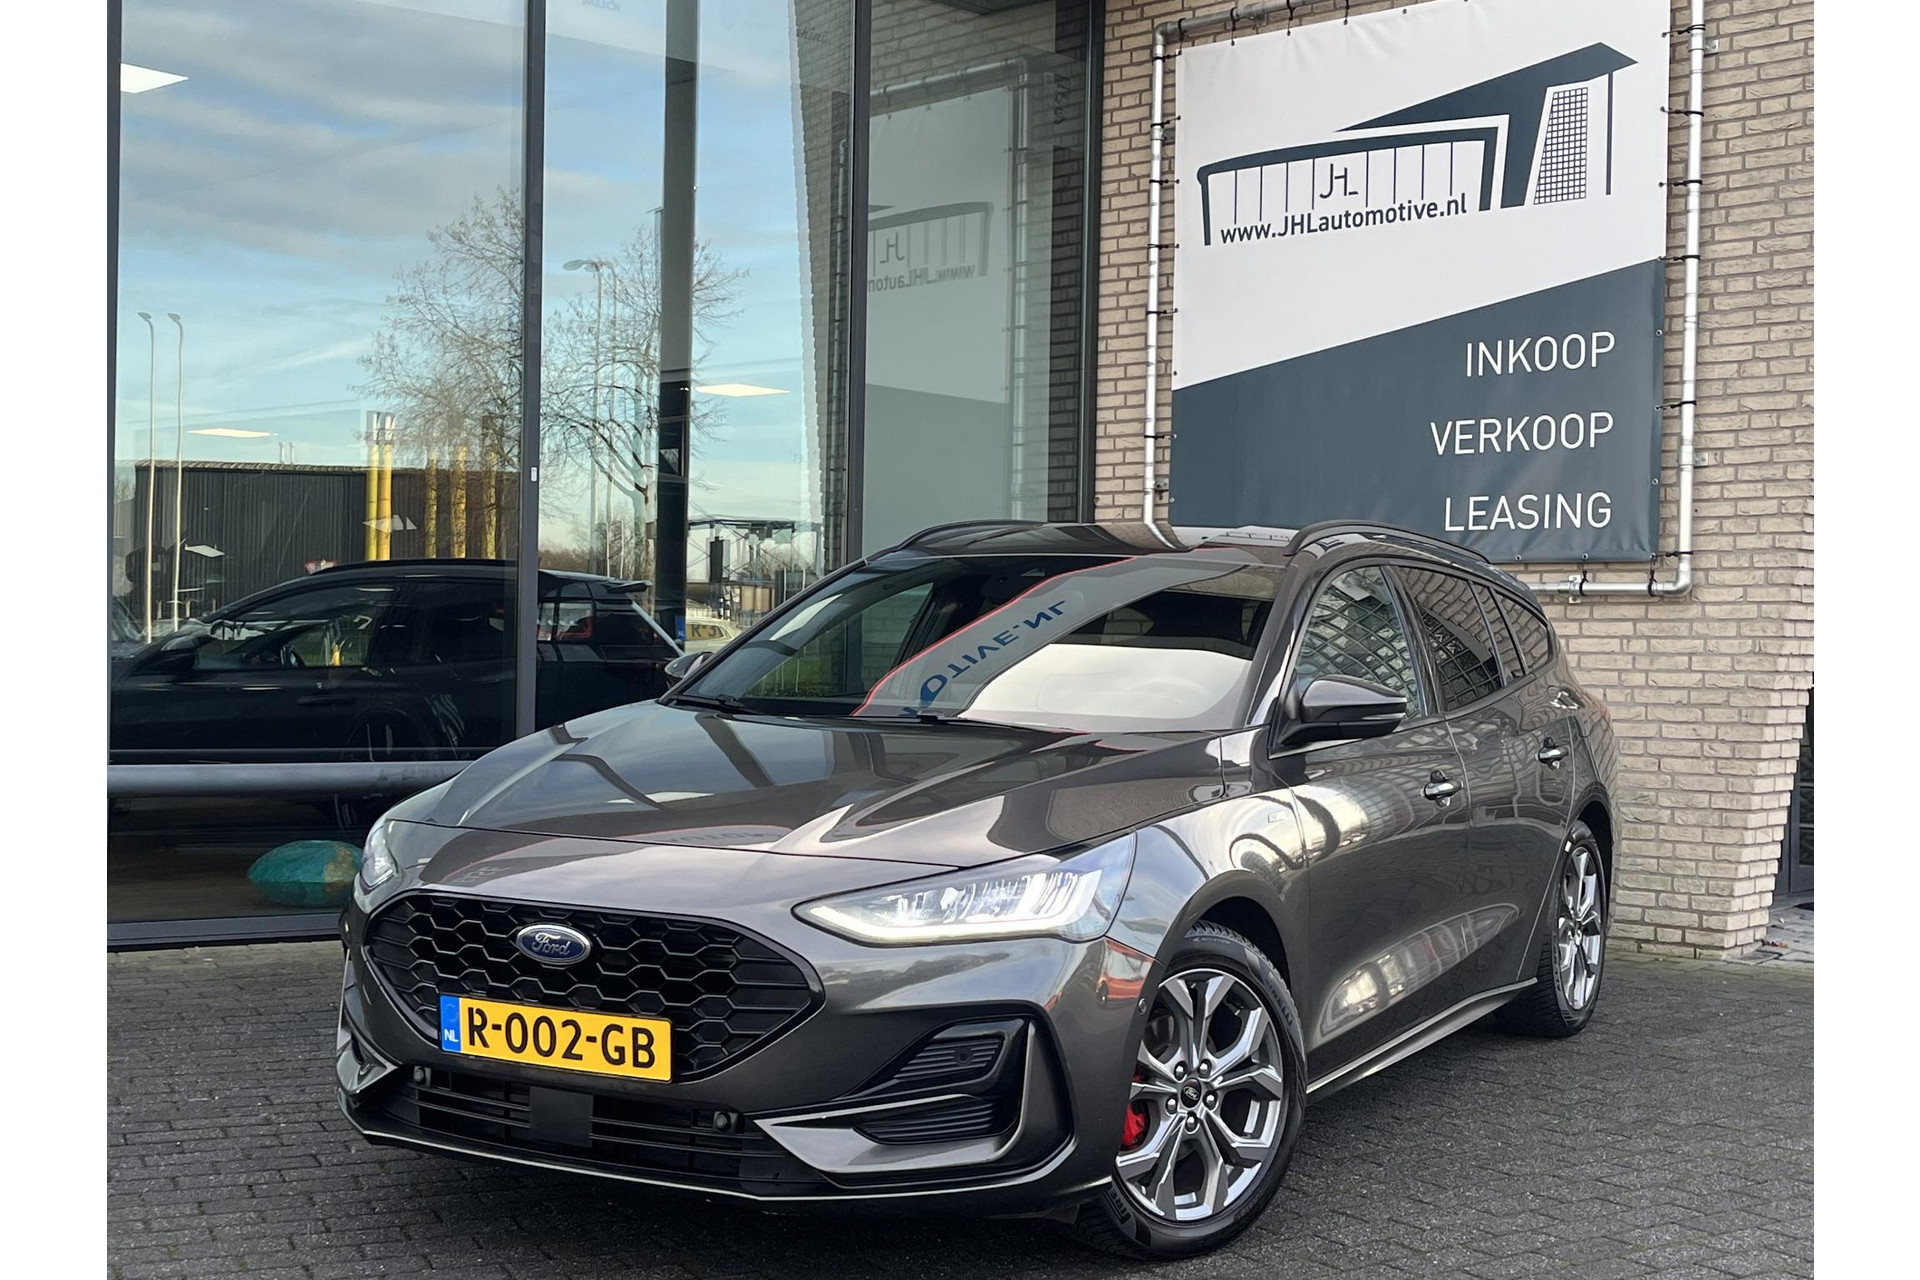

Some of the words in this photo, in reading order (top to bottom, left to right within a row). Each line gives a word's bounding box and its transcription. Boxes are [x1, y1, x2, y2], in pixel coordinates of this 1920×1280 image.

[1319, 163, 1359, 198] JHL
[1220, 192, 1467, 244] www.JHLautomotive.nl
[1466, 331, 1616, 377] INKOOP
[1430, 411, 1614, 456] VERKOOP
[1444, 491, 1612, 532] LEASING
[531, 932, 571, 956] Ford
[444, 1029, 459, 1043] NL
[467, 1006, 656, 1069] R-002-GB
